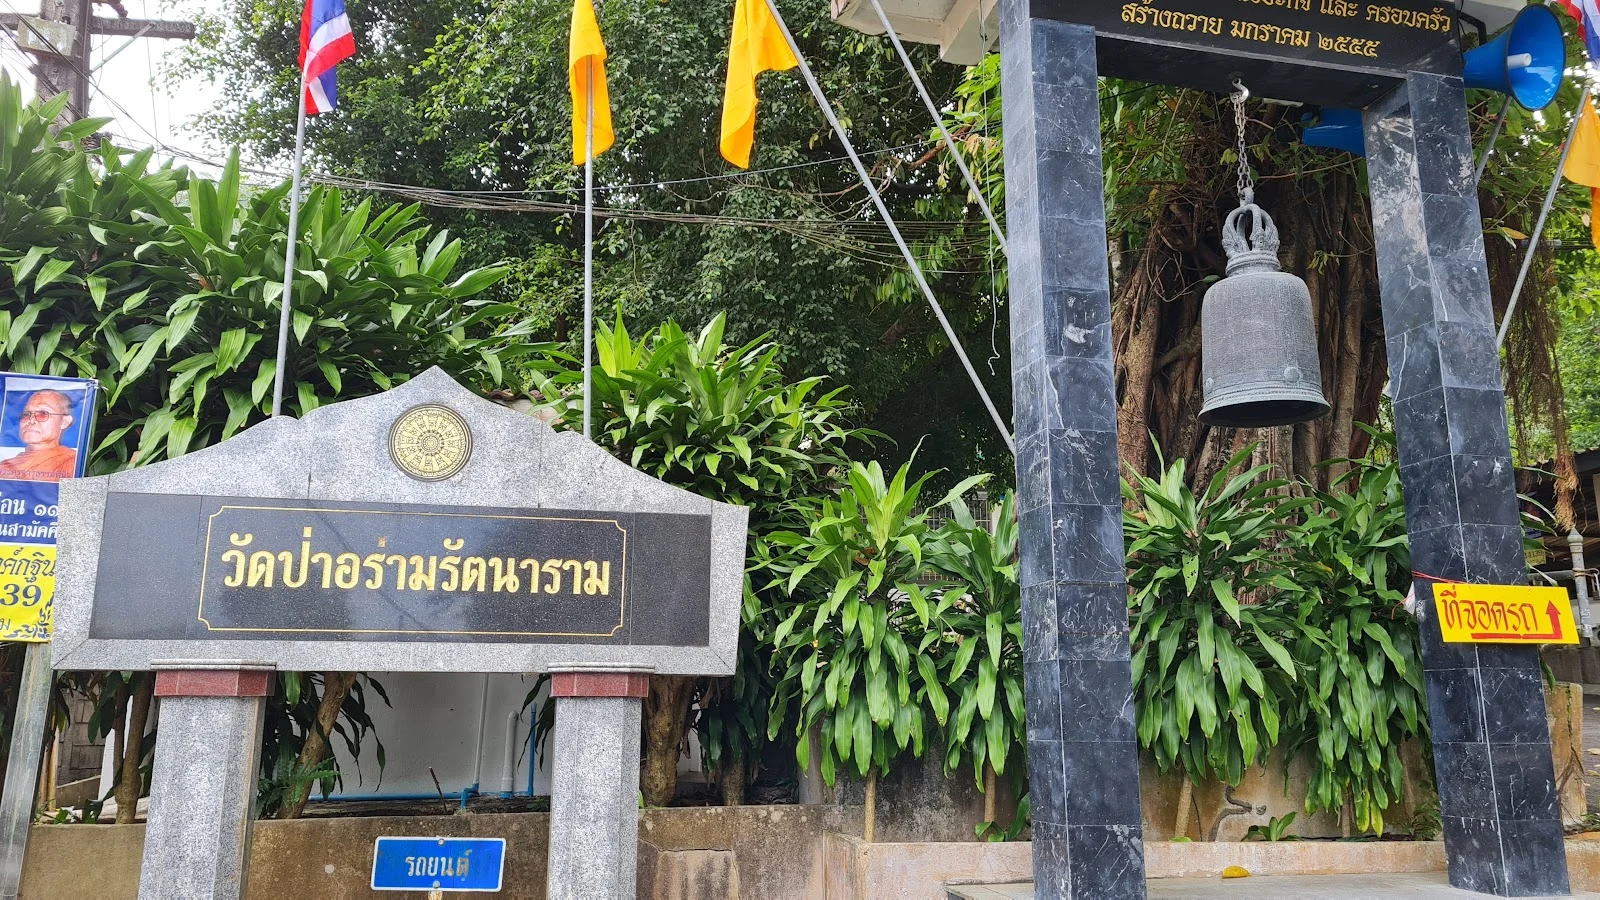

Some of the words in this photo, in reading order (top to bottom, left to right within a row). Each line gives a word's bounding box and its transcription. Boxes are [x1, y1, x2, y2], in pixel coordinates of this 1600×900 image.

[1121, 0, 1224, 35] สร้างถวาย
[1230, 19, 1311, 48] มกราคม
[1316, 31, 1381, 58] ๒๕๕๕
[1365, 4, 1451, 33] ครอบครัว
[0, 491, 25, 515] อน
[0, 547, 56, 583] ค์กฐิน
[221, 526, 611, 596] วัดป่าอร่ามรัตนาราม
[1440, 585, 1539, 632] ที่จอดรถ
[405, 849, 473, 877] รถยนต์
